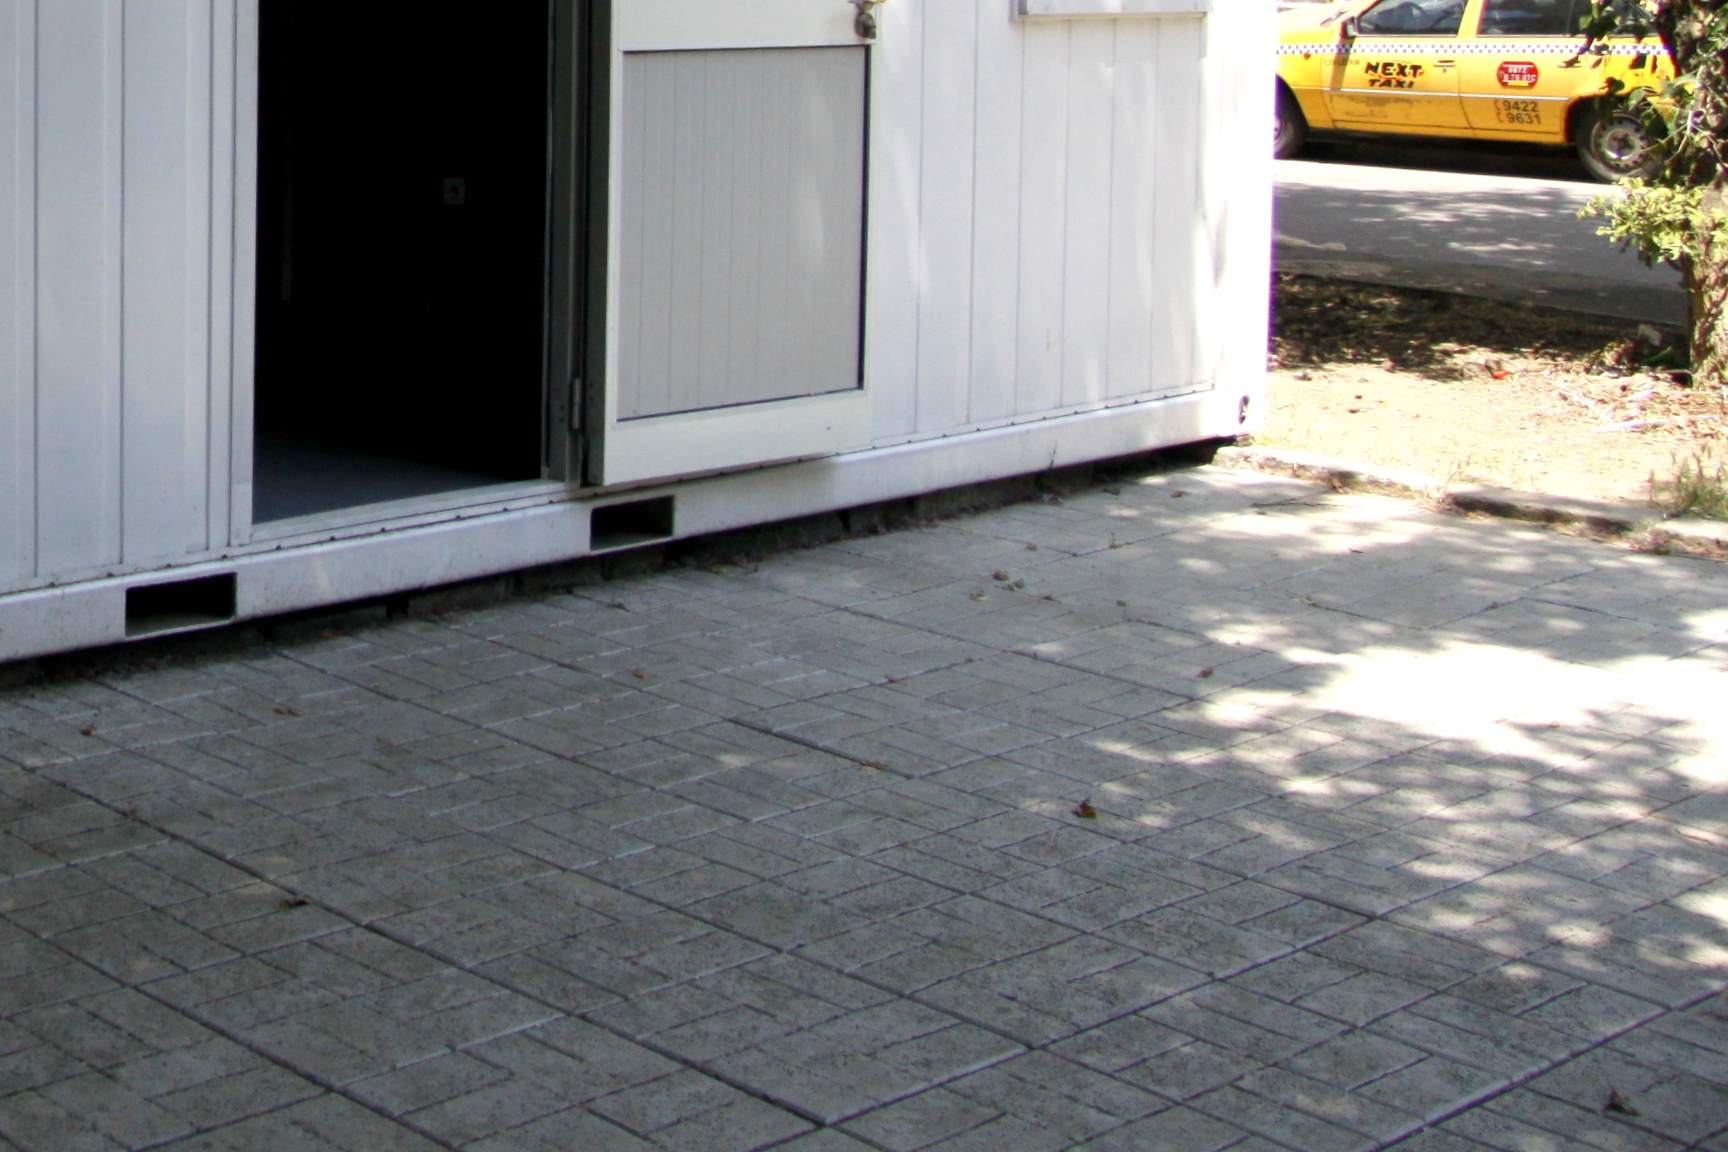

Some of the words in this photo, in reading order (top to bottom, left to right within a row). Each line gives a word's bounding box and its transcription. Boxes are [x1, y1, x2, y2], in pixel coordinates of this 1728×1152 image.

[1364, 61, 1423, 78] NEXT
[1368, 79, 1415, 88] TAXI
[1502, 100, 1539, 113] 9422
[1506, 112, 1542, 125] 9631
